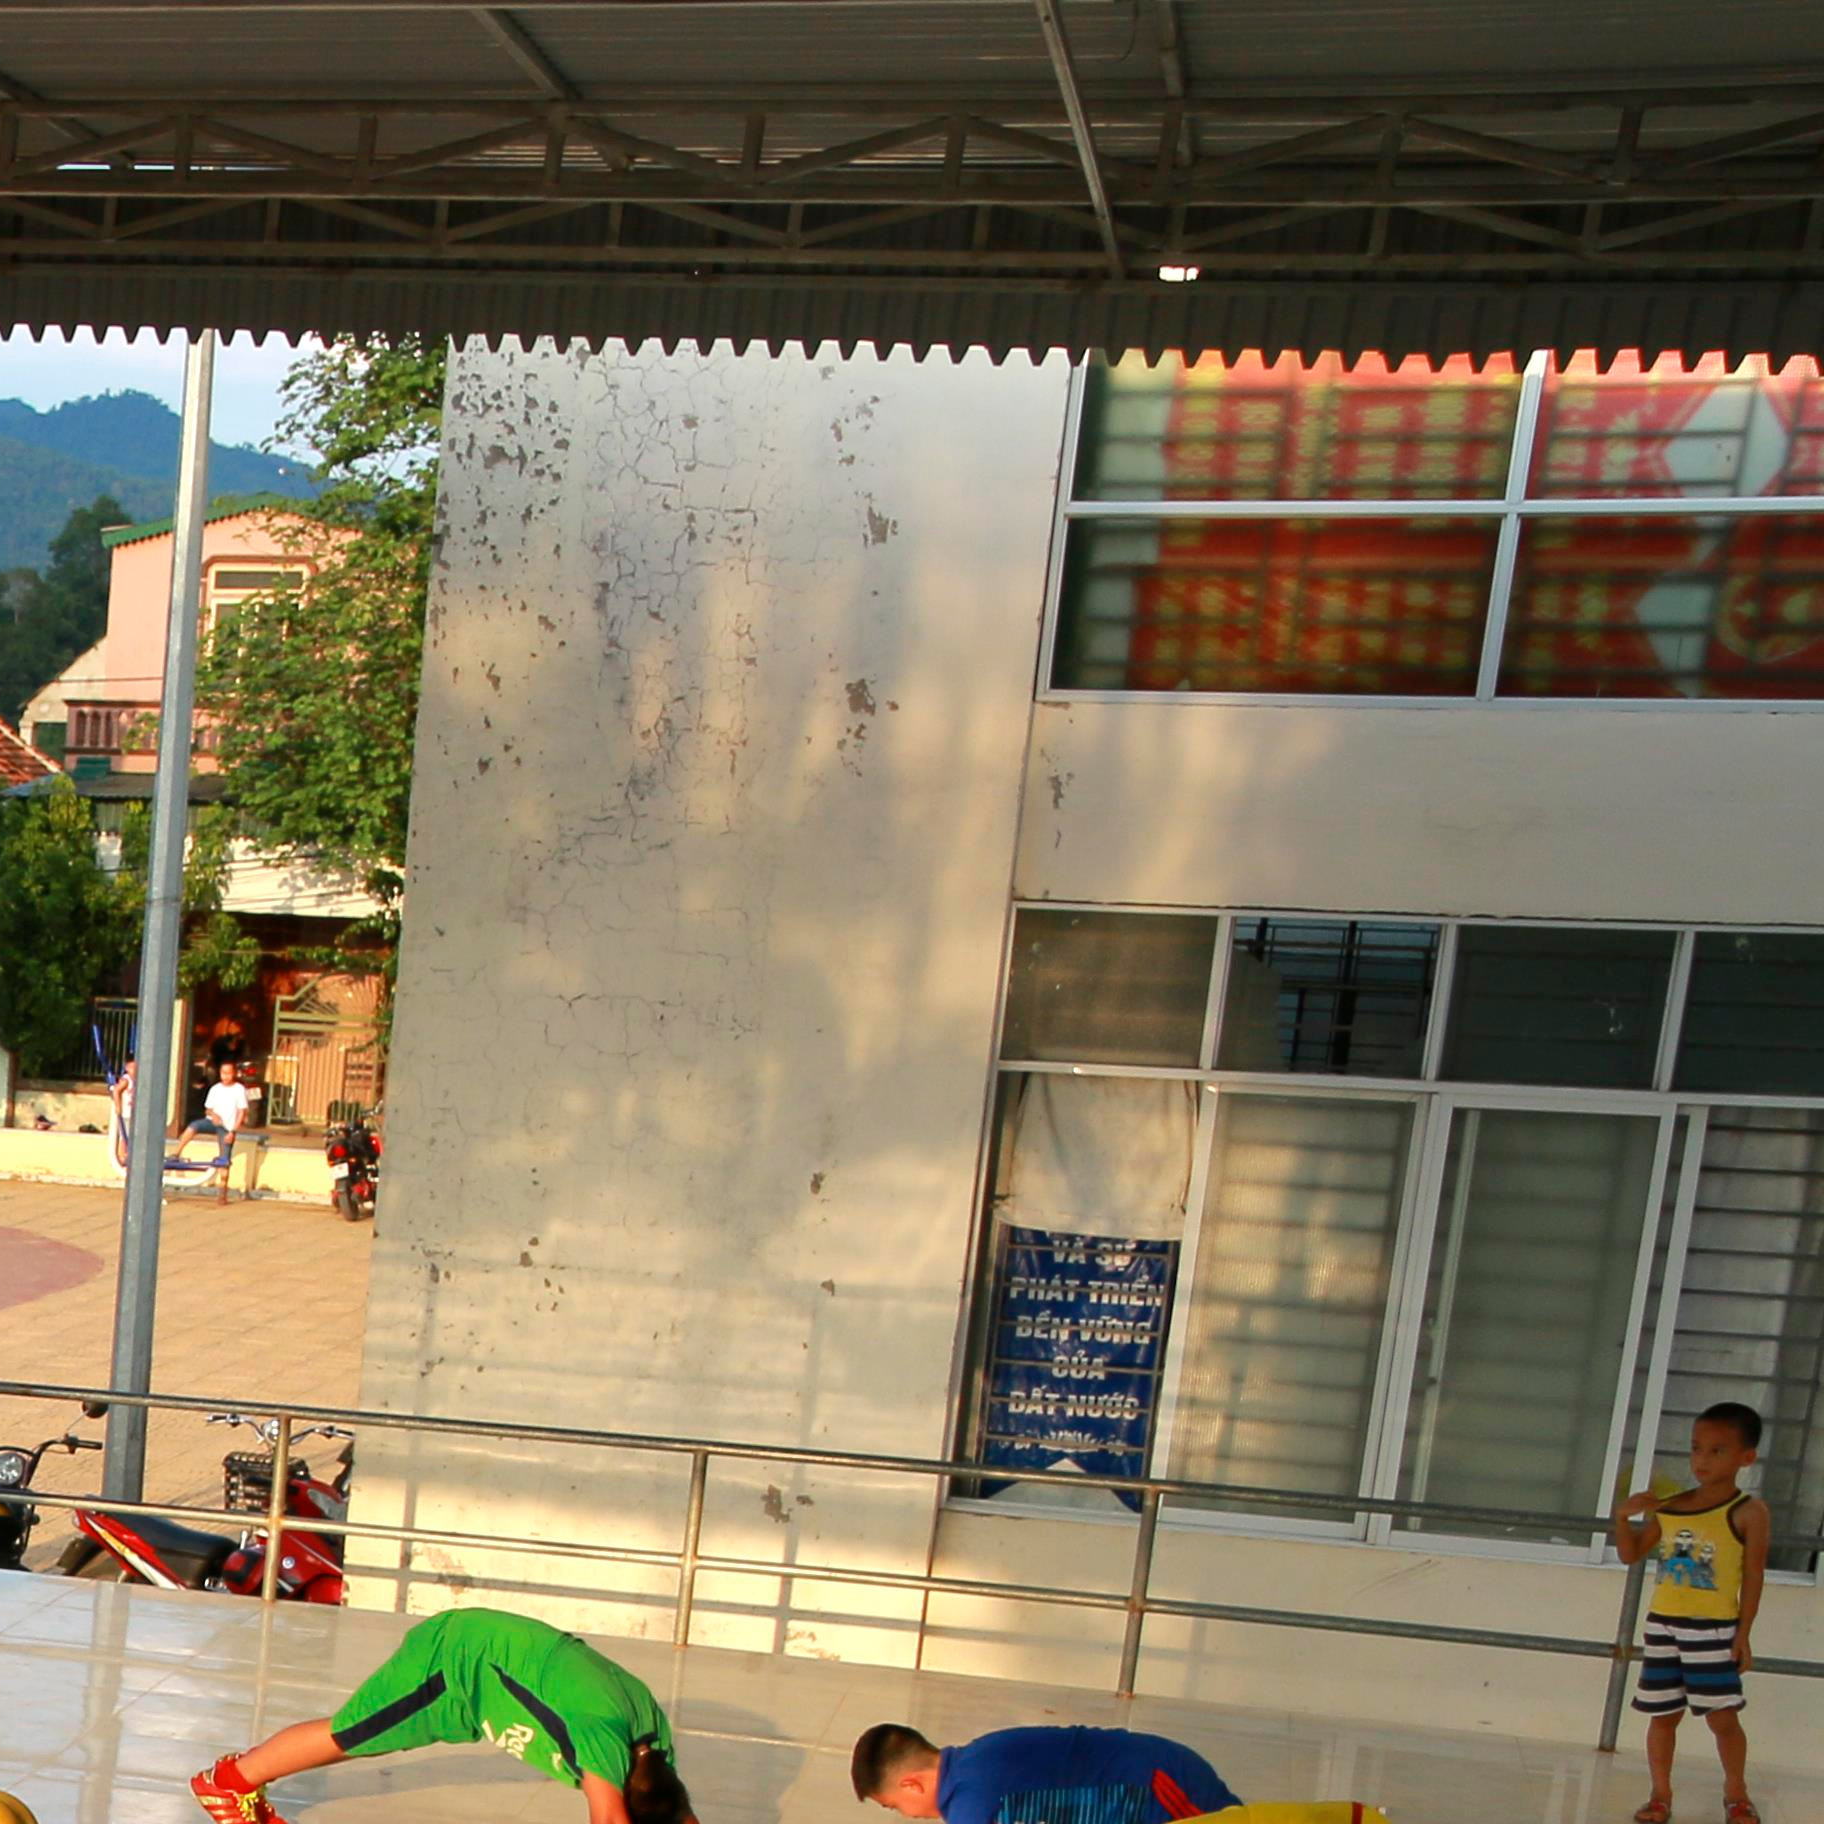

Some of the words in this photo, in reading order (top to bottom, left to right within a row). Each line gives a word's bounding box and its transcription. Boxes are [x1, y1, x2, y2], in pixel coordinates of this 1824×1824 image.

[1009, 1273, 1080, 1302] PHÁT
[1087, 1274, 1165, 1306] TRIỂN
[1052, 1349, 1106, 1380] CỦA
[1065, 1392, 1140, 1421] NƯỚC
